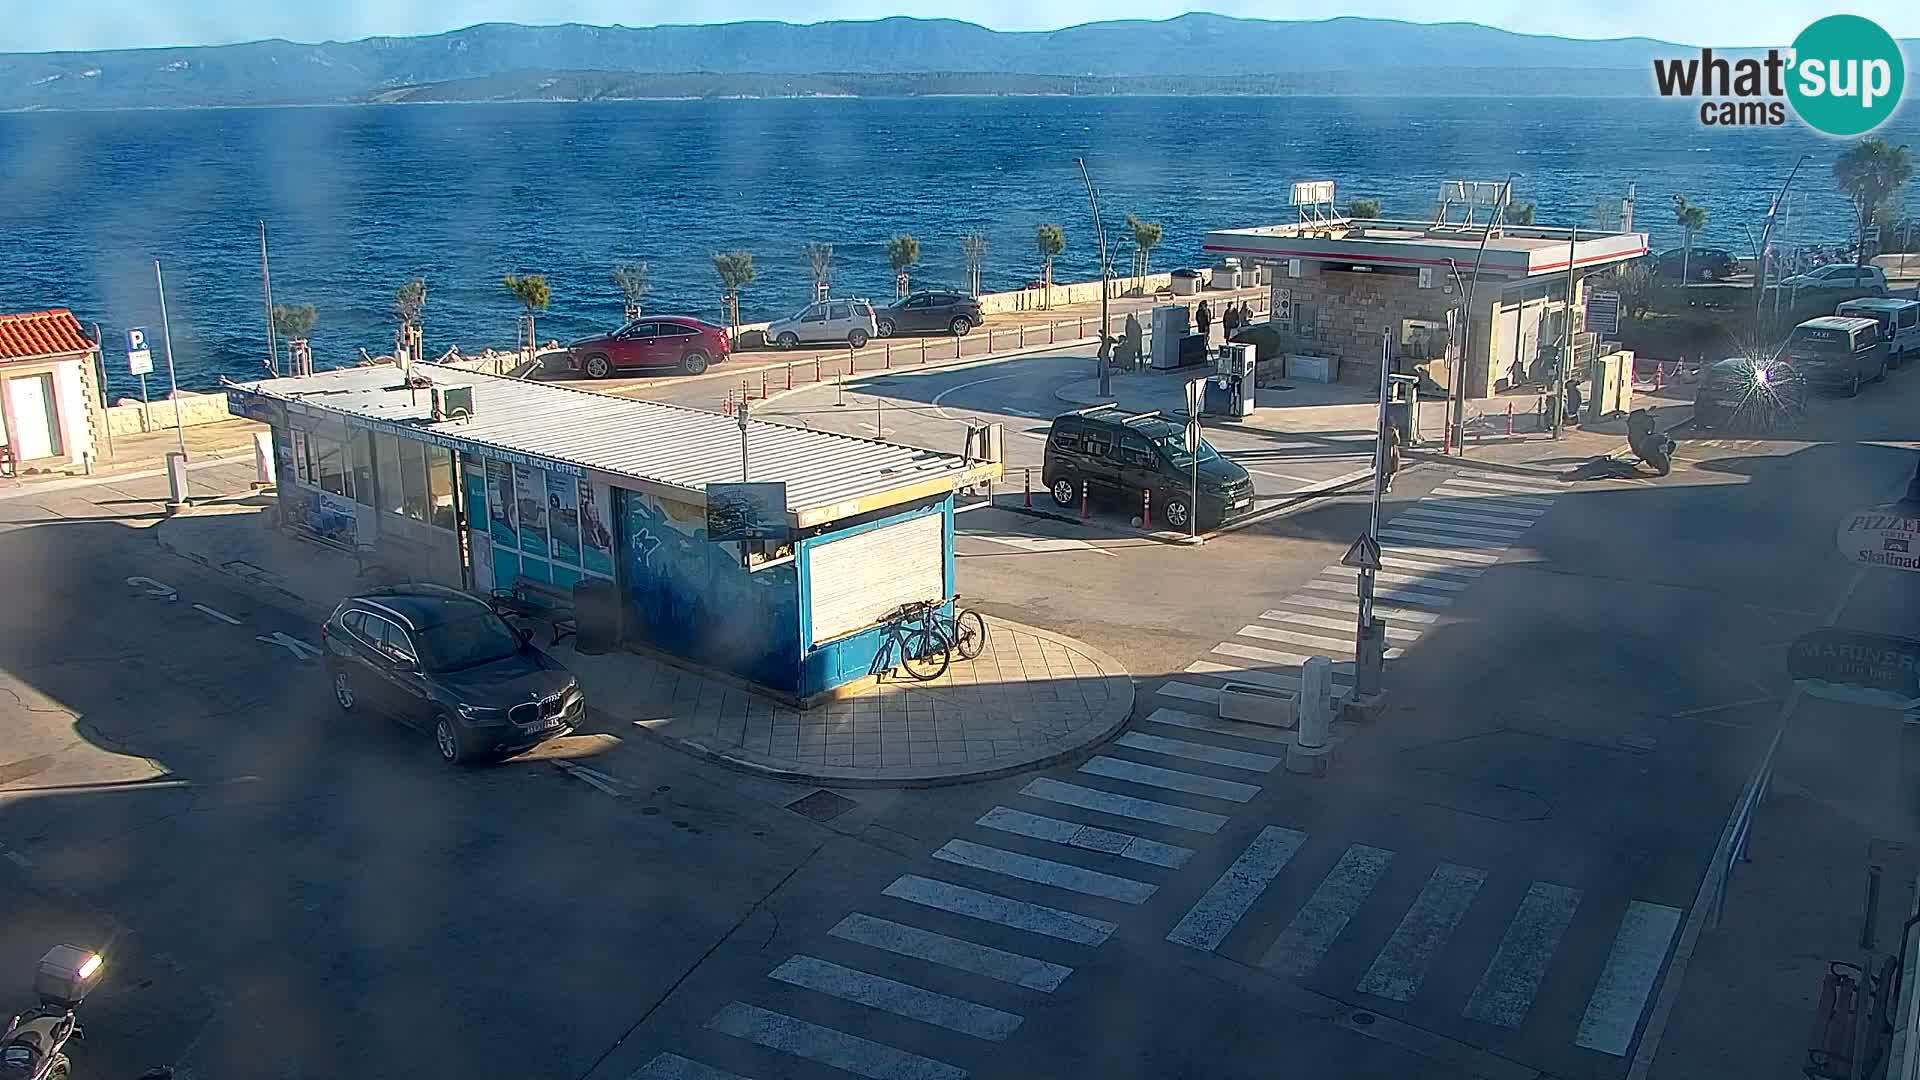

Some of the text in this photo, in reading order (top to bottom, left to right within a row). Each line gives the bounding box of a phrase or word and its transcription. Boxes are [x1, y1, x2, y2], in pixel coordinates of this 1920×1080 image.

[130, 330, 144, 350] P
[438, 436, 468, 451] POSTAJA
[479, 447, 493, 457] BUS
[495, 449, 527, 464] STATION
[529, 457, 555, 471] TICKET
[556, 463, 582, 477] OFFICE
